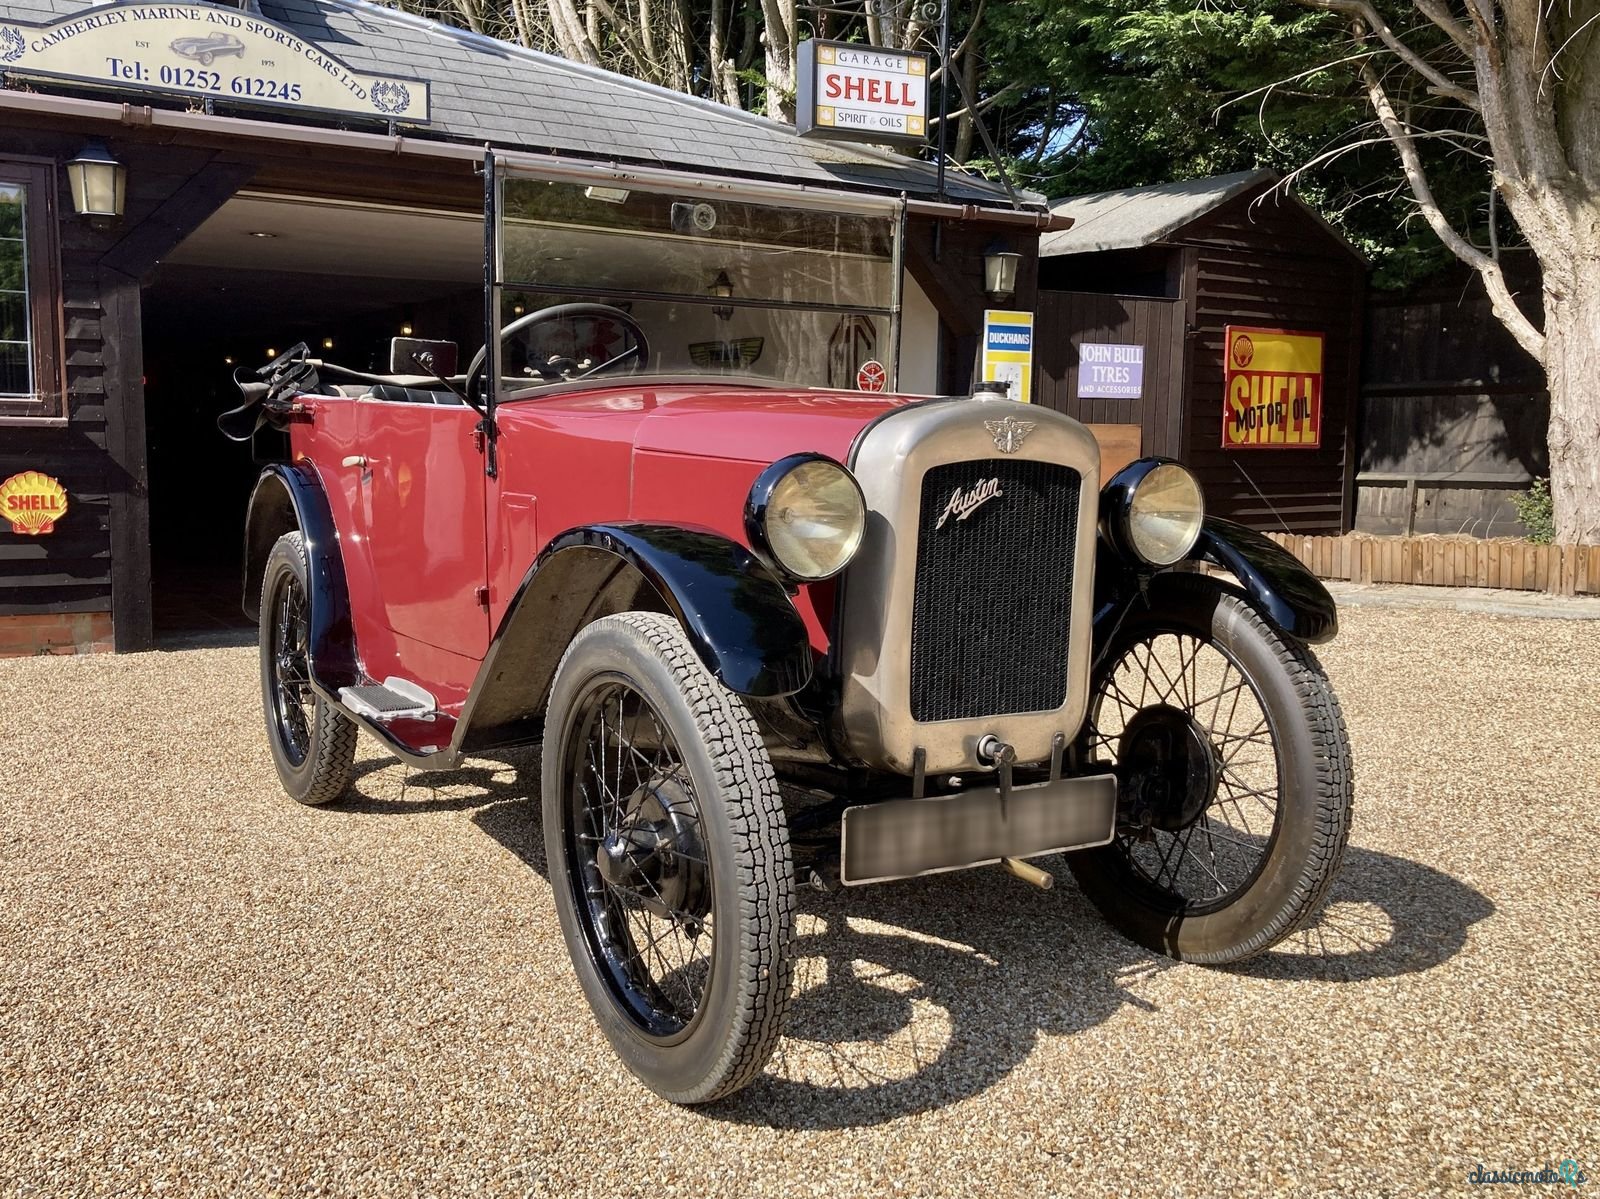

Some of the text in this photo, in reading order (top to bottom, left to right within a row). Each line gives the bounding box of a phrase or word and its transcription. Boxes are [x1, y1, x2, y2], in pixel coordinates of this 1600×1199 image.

[135, 40, 150, 49] EST
[31, 7, 367, 101] CAMBERLEY MARINE AND SPORTS CARS LTD
[839, 51, 902, 69] GARAGE
[261, 59, 275, 68] 1975
[106, 57, 302, 102] Tel: 01252 612245
[825, 73, 916, 107] SHELL
[838, 112, 902, 128] SPIRIT & OILS
[989, 331, 1030, 345] DUCKHAMS
[1079, 345, 1143, 364] JOHN BULL
[1092, 365, 1130, 383] TYRES
[1080, 384, 1142, 394] AND ACCESSORIES
[1228, 374, 1316, 443] SHELL
[1235, 396, 1311, 433] MOTOR OIL
[7, 494, 60, 510] SHELL
[935, 477, 1003, 530] Austin
